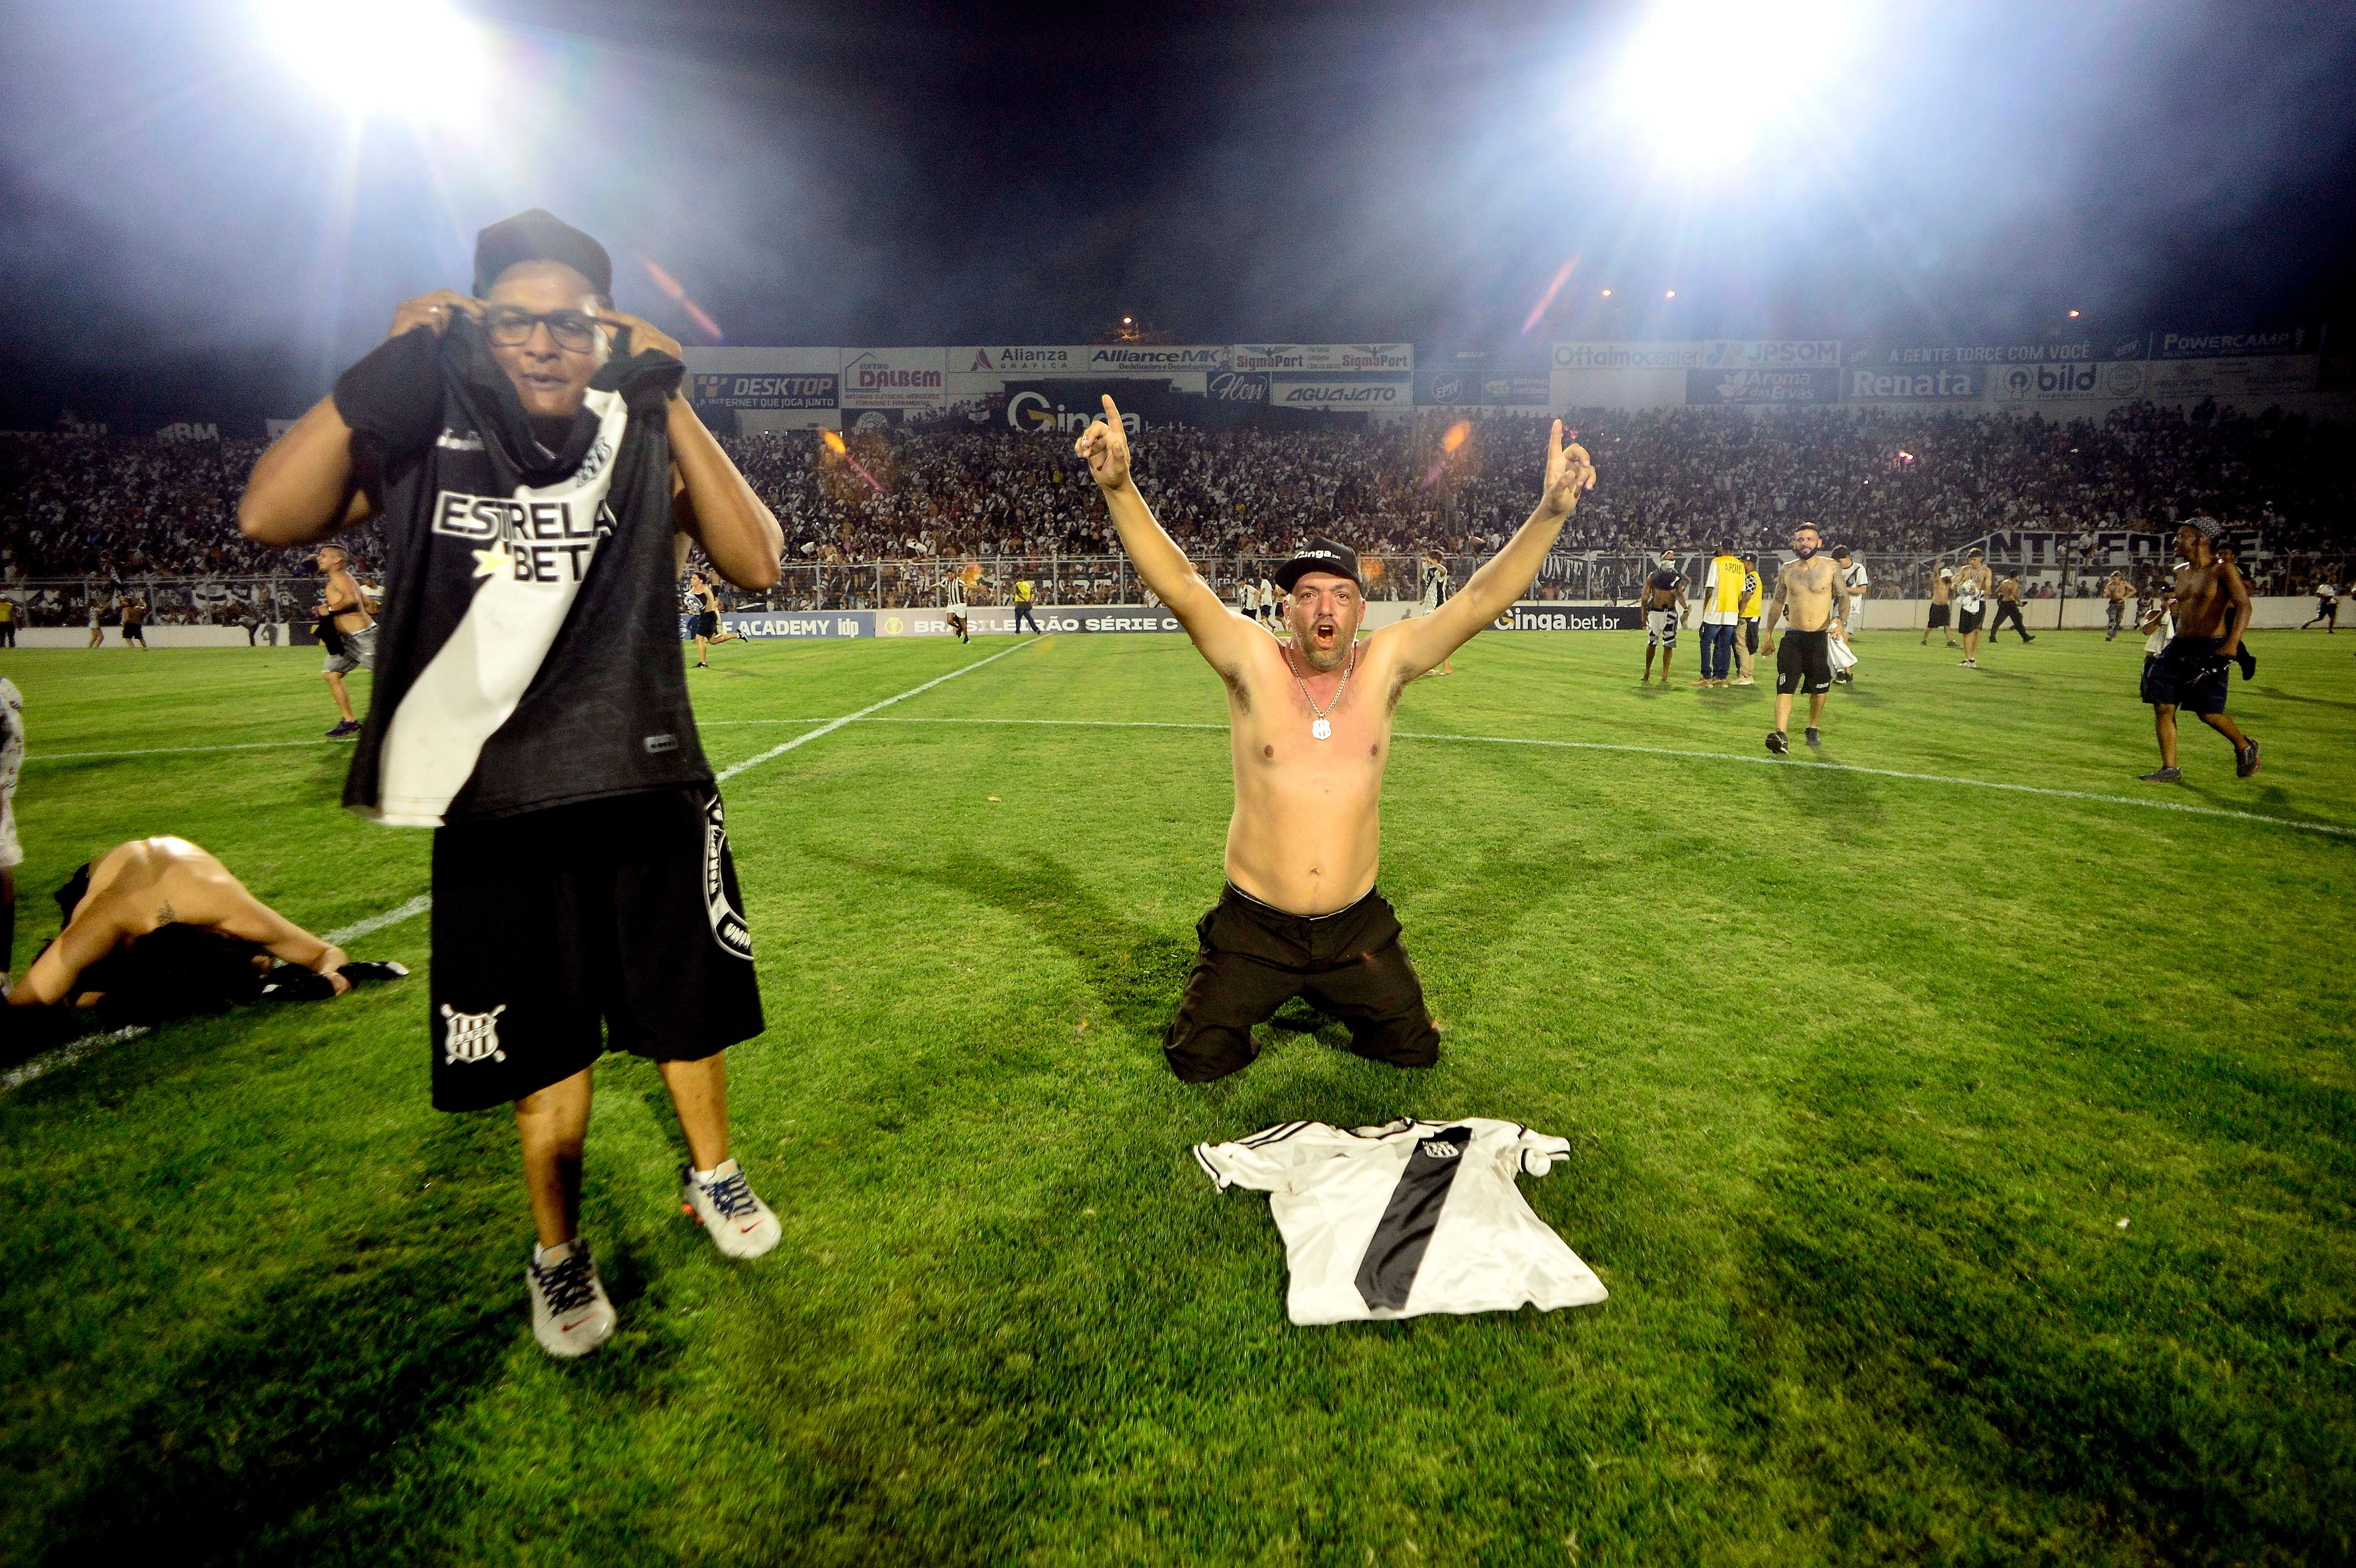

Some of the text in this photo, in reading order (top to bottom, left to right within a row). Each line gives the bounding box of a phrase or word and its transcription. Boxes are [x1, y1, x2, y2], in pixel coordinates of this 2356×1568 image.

[1001, 349, 1067, 361] Alianza
[1092, 350, 1220, 362] AllianceMK
[1890, 341, 2090, 362] A GENTE TORCE COM VOCÊ
[1237, 354, 1303, 371] SigmaPort
[1342, 354, 1408, 371] SigmaPort
[733, 377, 833, 395] DESKTOP
[859, 371, 941, 387] DALBEM
[1851, 370, 1972, 398] Renata
[2038, 366, 2096, 392] bild
[709, 398, 758, 407] INTERNET
[761, 398, 779, 407] QUE
[781, 398, 803, 407] JOGA
[806, 398, 833, 407] JUNTO
[1286, 388, 1396, 401] AGUAJATO
[432, 491, 617, 541] ESTRELA
[513, 544, 590, 582] BET
[1725, 563, 1742, 575] APOIO
[739, 620, 830, 636] ACADEMY
[1085, 617, 1157, 631] SÉRIE
[1162, 619, 1178, 630] C
